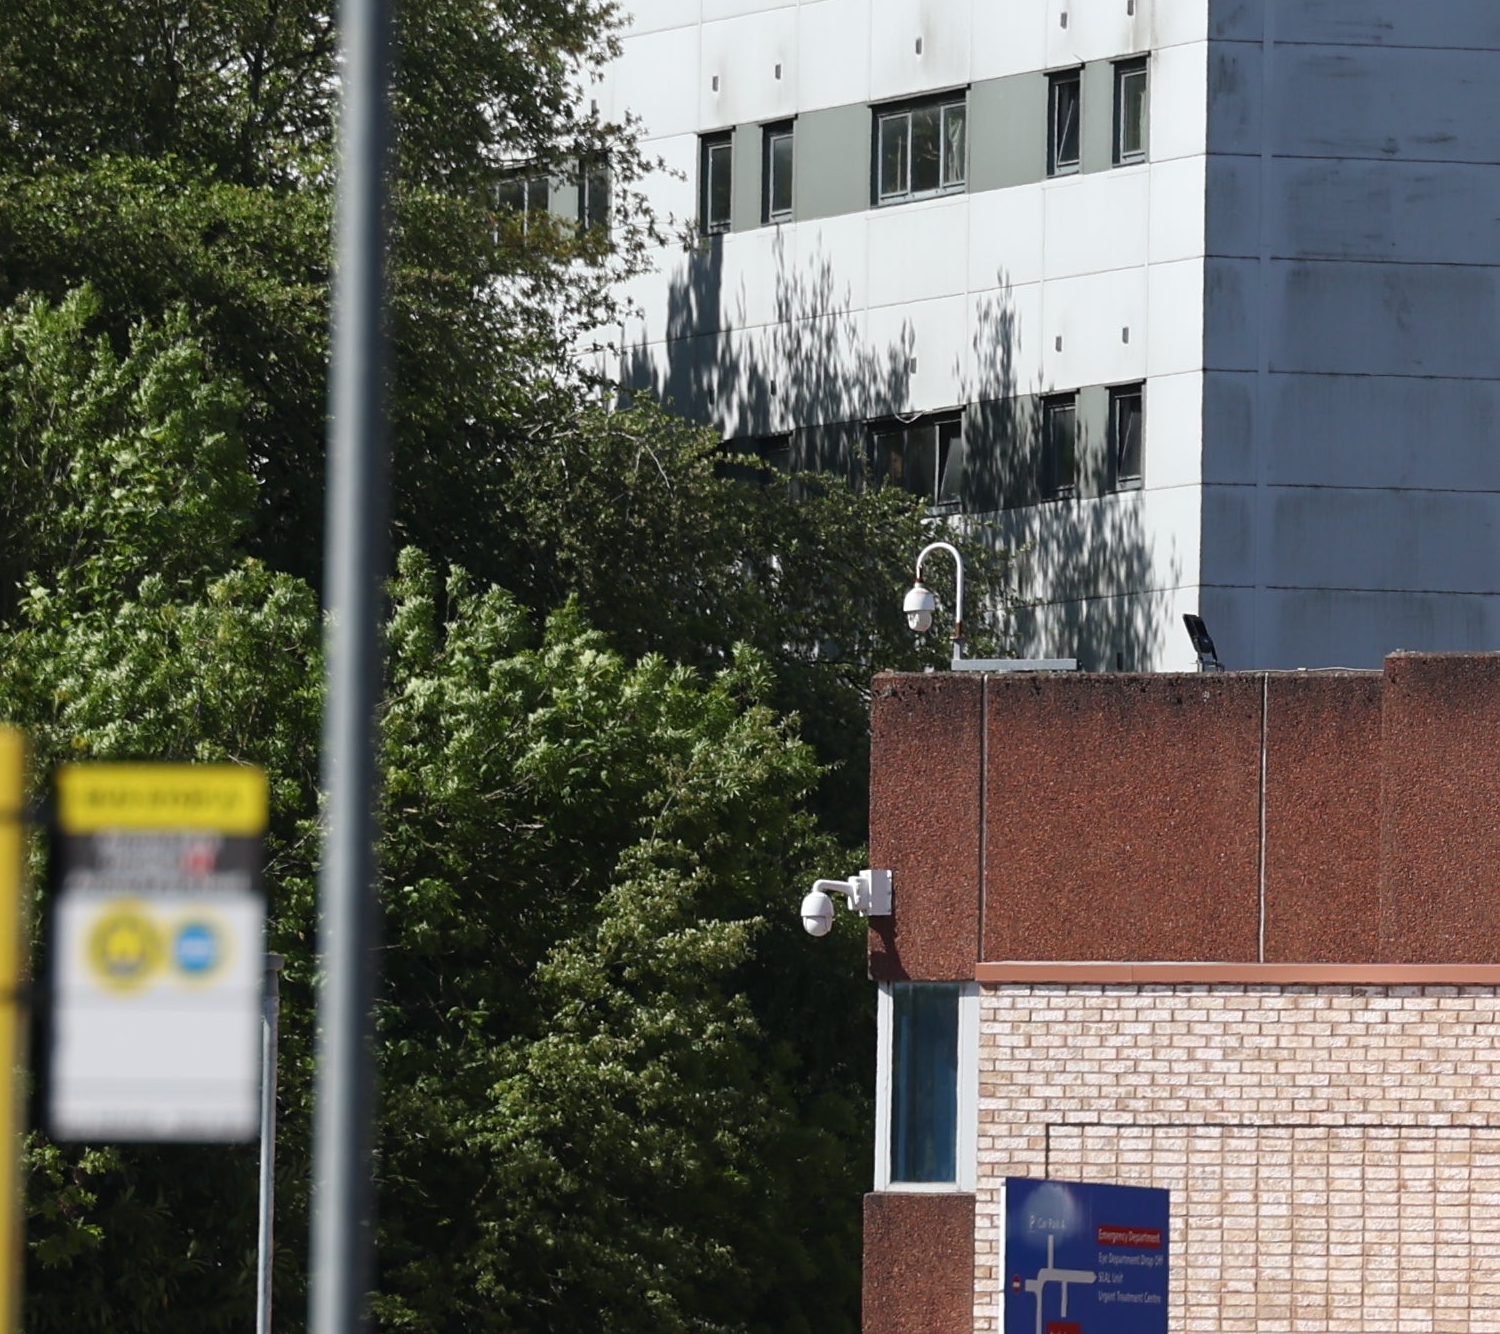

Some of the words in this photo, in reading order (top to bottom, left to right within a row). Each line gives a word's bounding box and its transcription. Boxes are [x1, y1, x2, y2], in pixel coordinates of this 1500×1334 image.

[1098, 1228, 1127, 1244] Emergency
[1128, 1231, 1161, 1245] Department
[1109, 1253, 1139, 1267] Department
[1140, 1255, 1154, 1268] Drop
[1112, 1273, 1123, 1284] Unit
[1098, 1291, 1117, 1303] Urgent
[1117, 1292, 1141, 1304] Treatment
[1143, 1293, 1161, 1304] Centre
